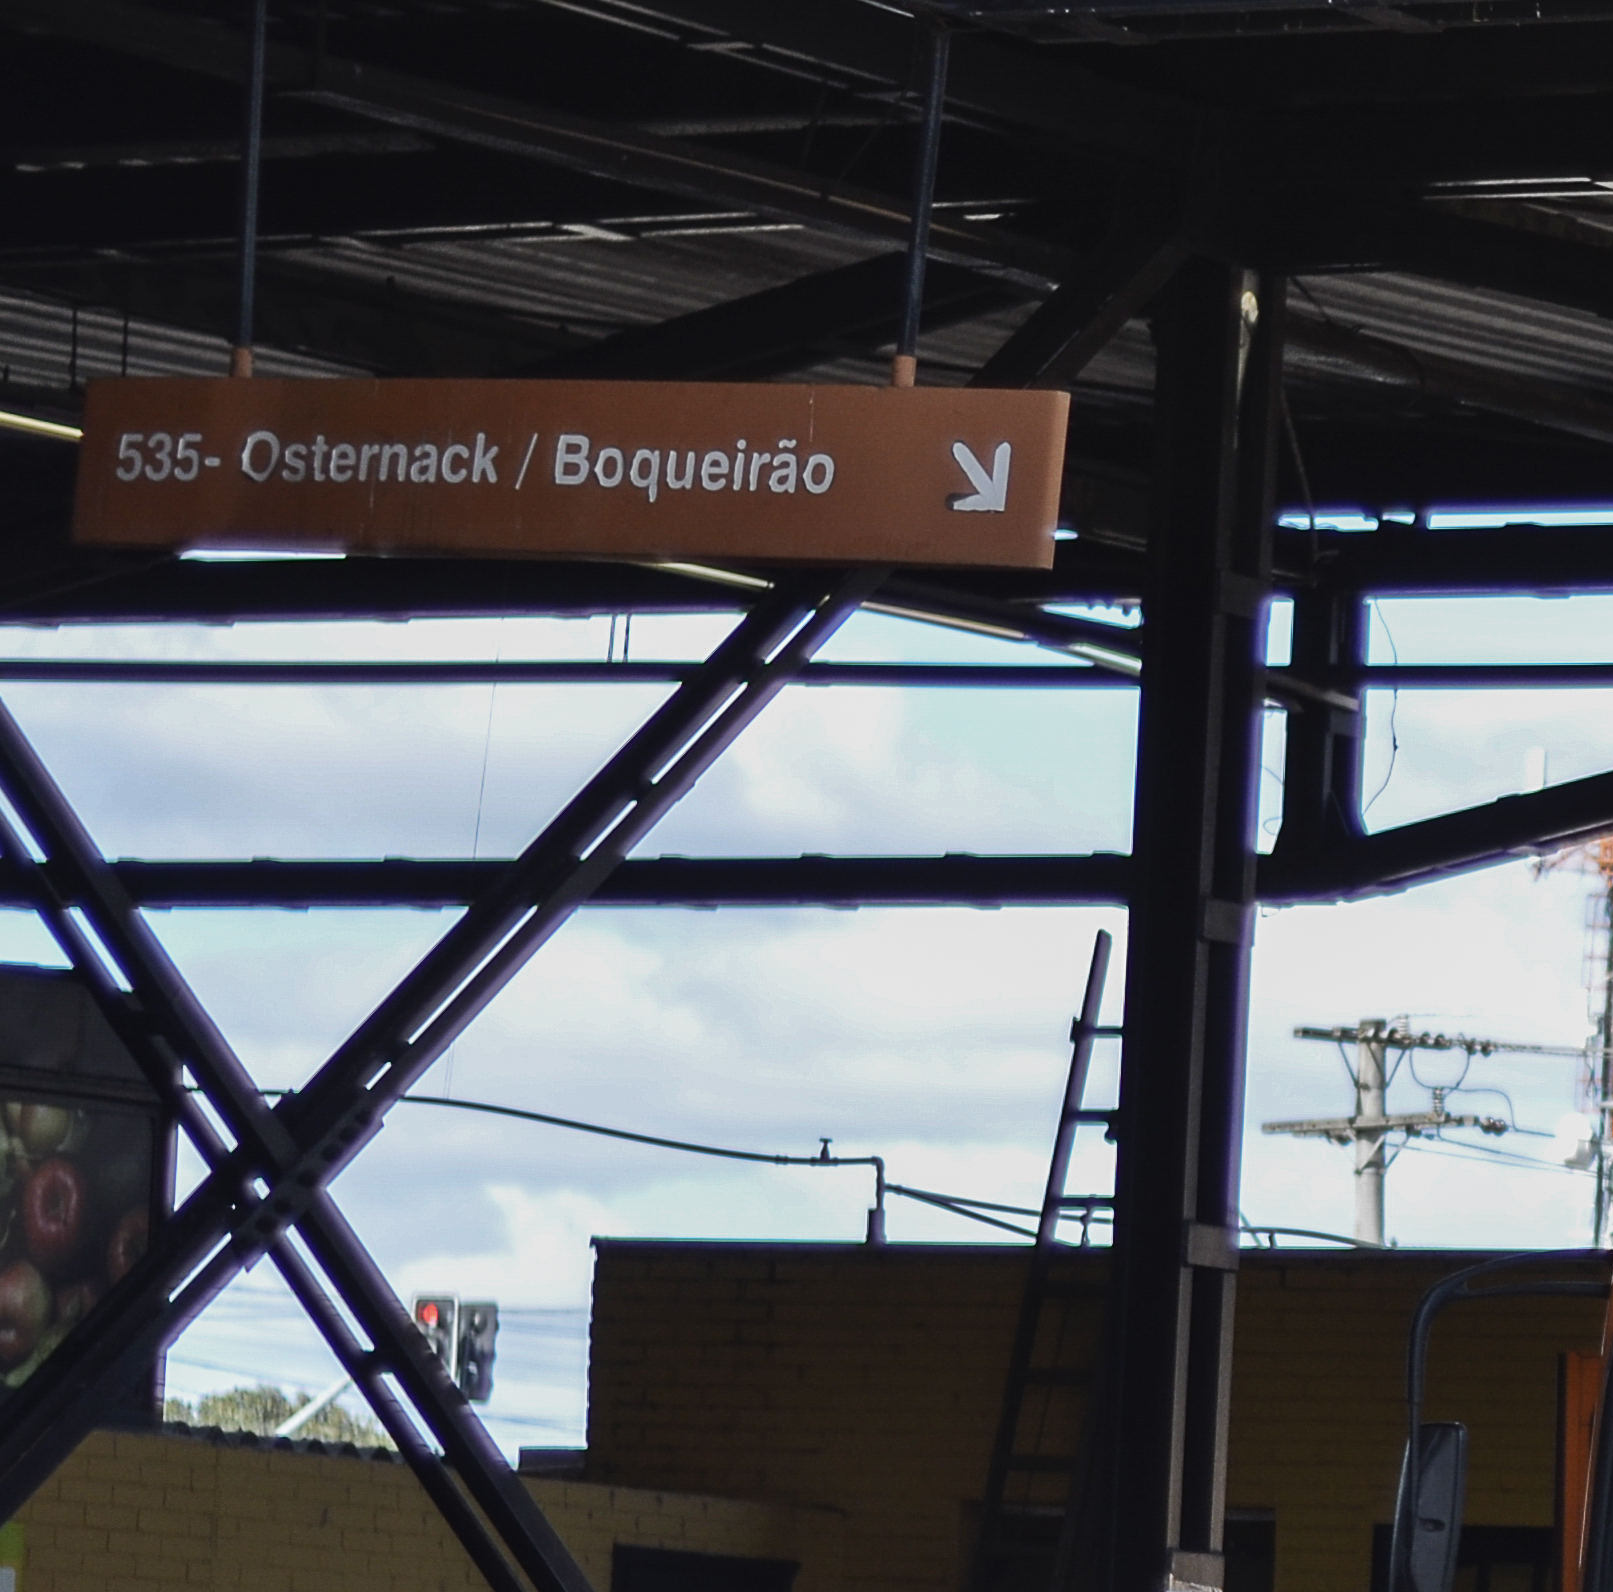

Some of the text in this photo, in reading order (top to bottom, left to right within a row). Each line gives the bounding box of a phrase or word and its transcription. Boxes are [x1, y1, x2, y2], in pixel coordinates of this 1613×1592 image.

[116, 429, 835, 503] 535- Osternack / Boqueirão
